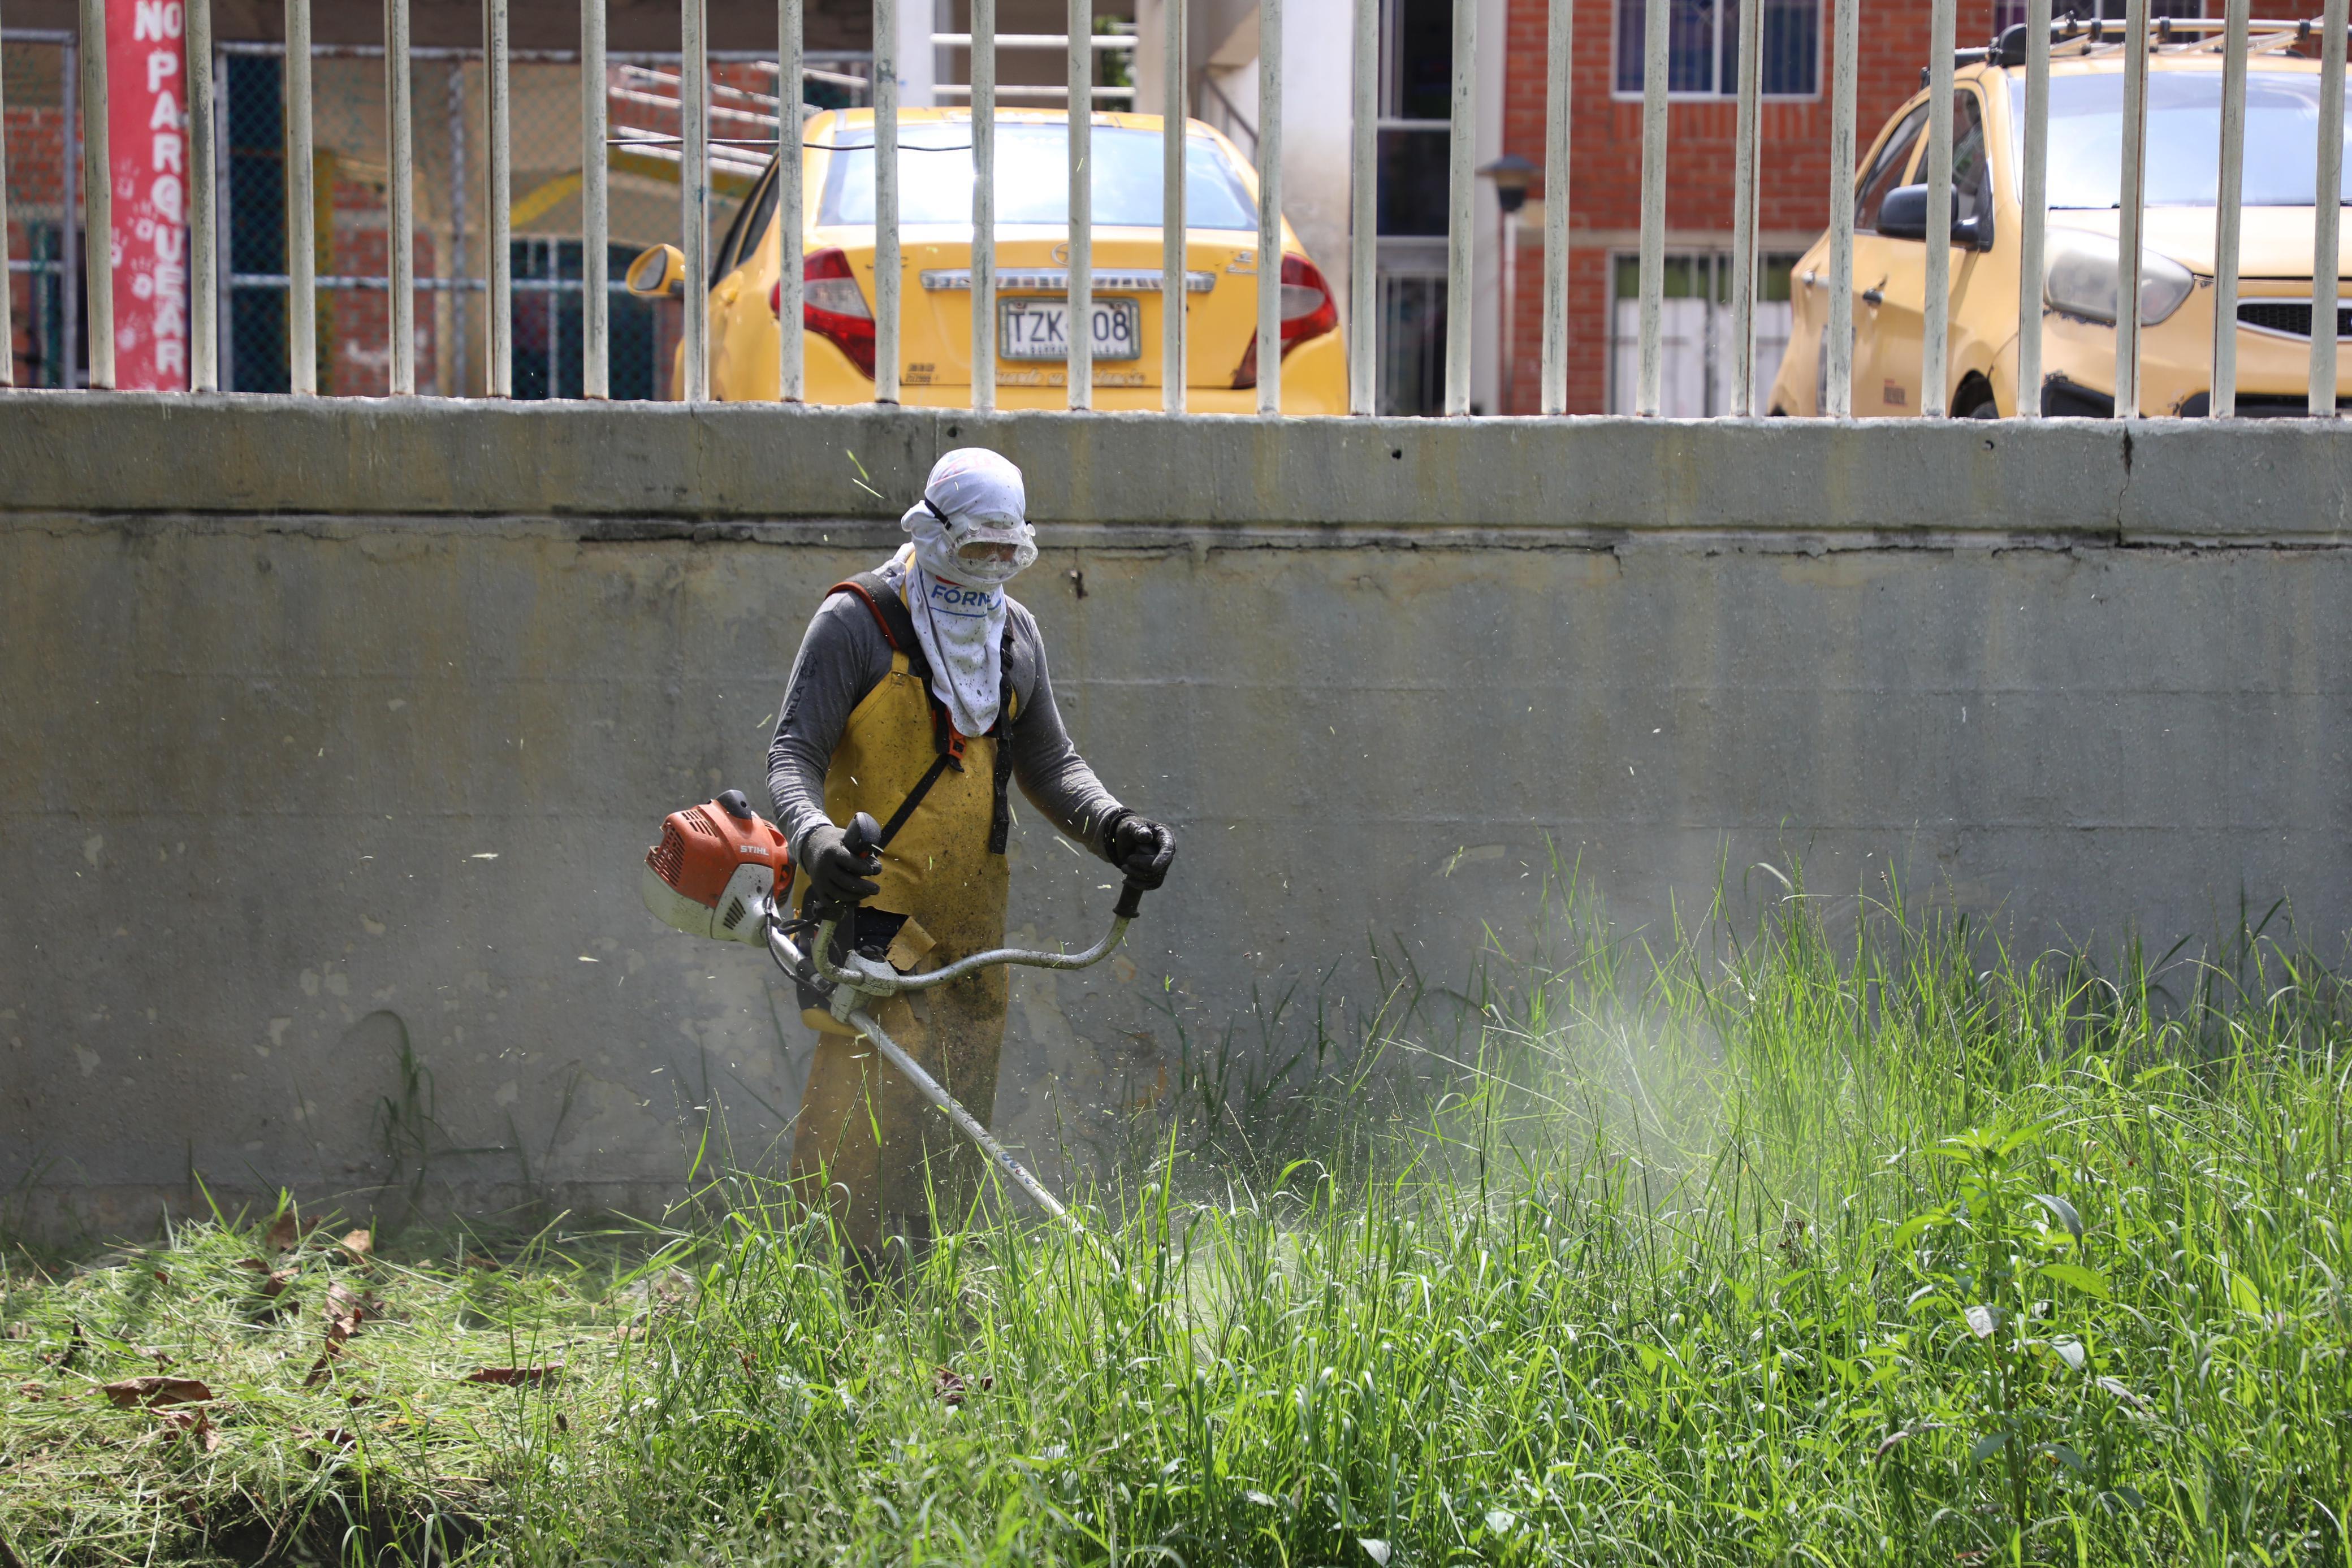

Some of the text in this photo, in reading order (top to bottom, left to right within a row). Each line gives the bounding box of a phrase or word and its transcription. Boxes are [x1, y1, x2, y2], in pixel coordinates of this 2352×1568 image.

[133, 1, 183, 42] NO
[147, 51, 185, 376] PARQUEAR
[741, 845, 769, 856] STIHL
